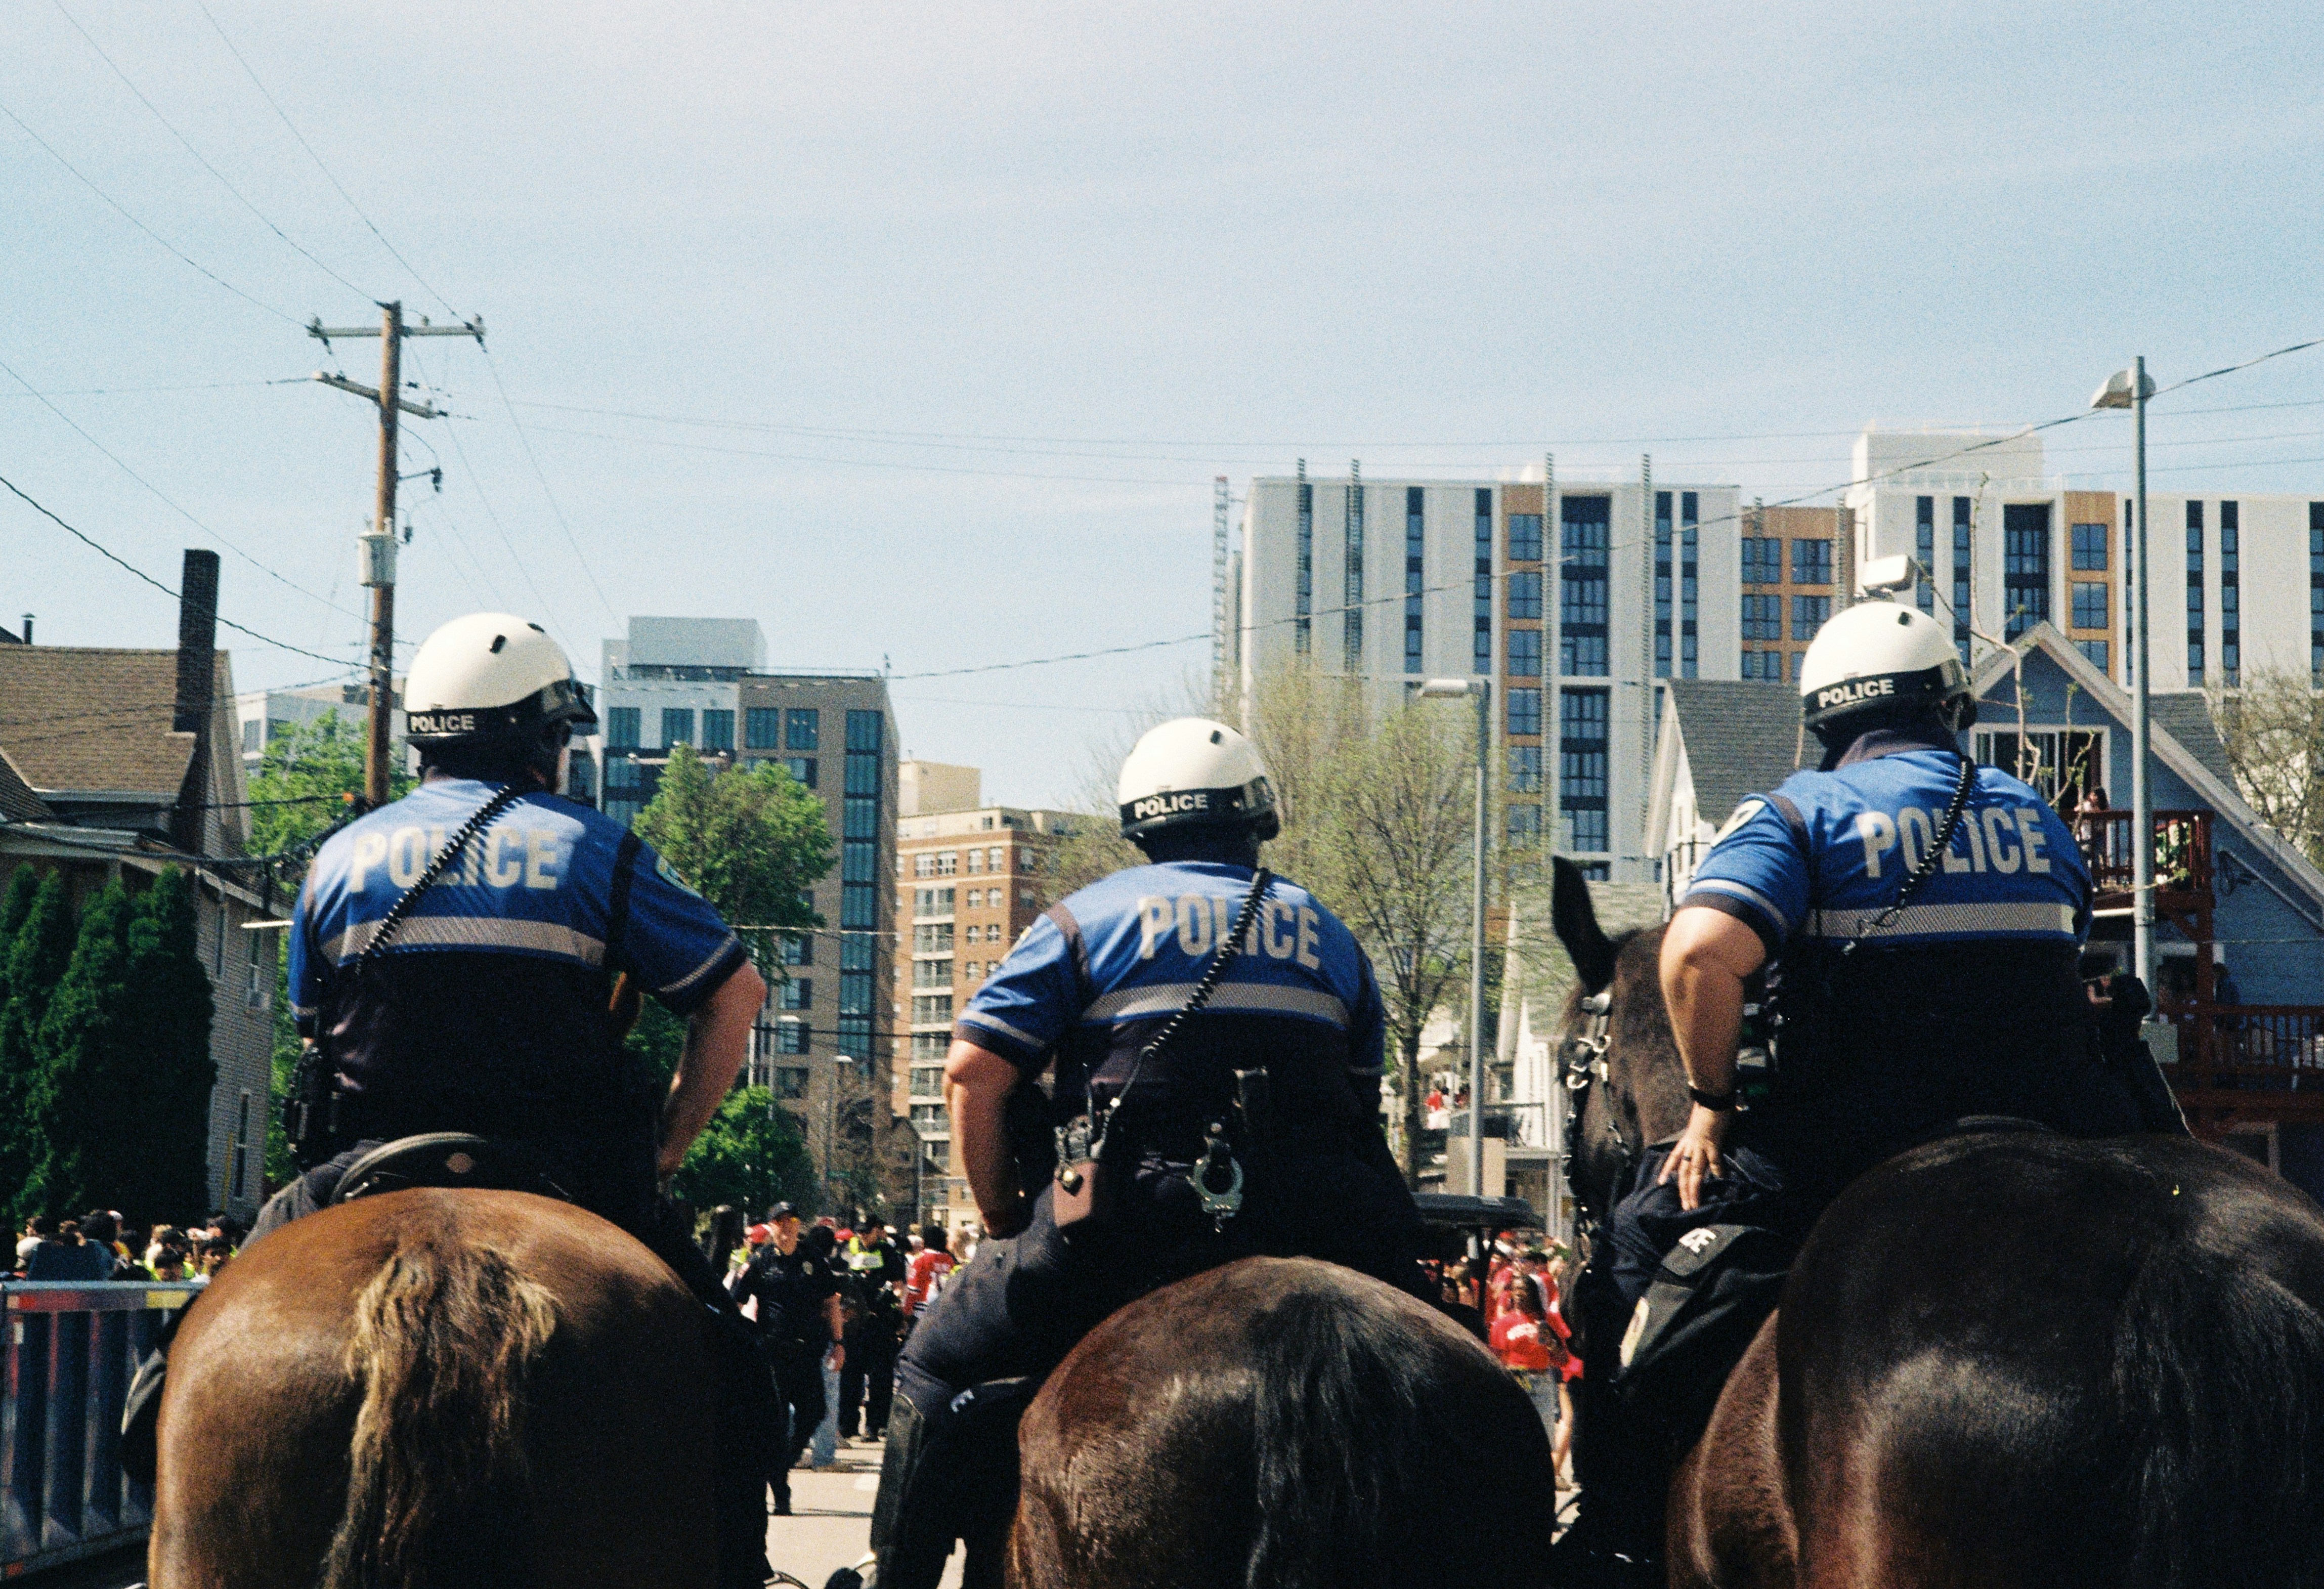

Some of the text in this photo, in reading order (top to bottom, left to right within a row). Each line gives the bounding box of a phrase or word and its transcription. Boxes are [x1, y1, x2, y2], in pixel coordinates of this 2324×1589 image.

[1818, 679, 1895, 708] POLICE
[410, 715, 475, 732] POLICE
[1135, 794, 1208, 819] POLICE
[1855, 807, 2050, 878] POLICE
[1138, 893, 1320, 969] POLICE
